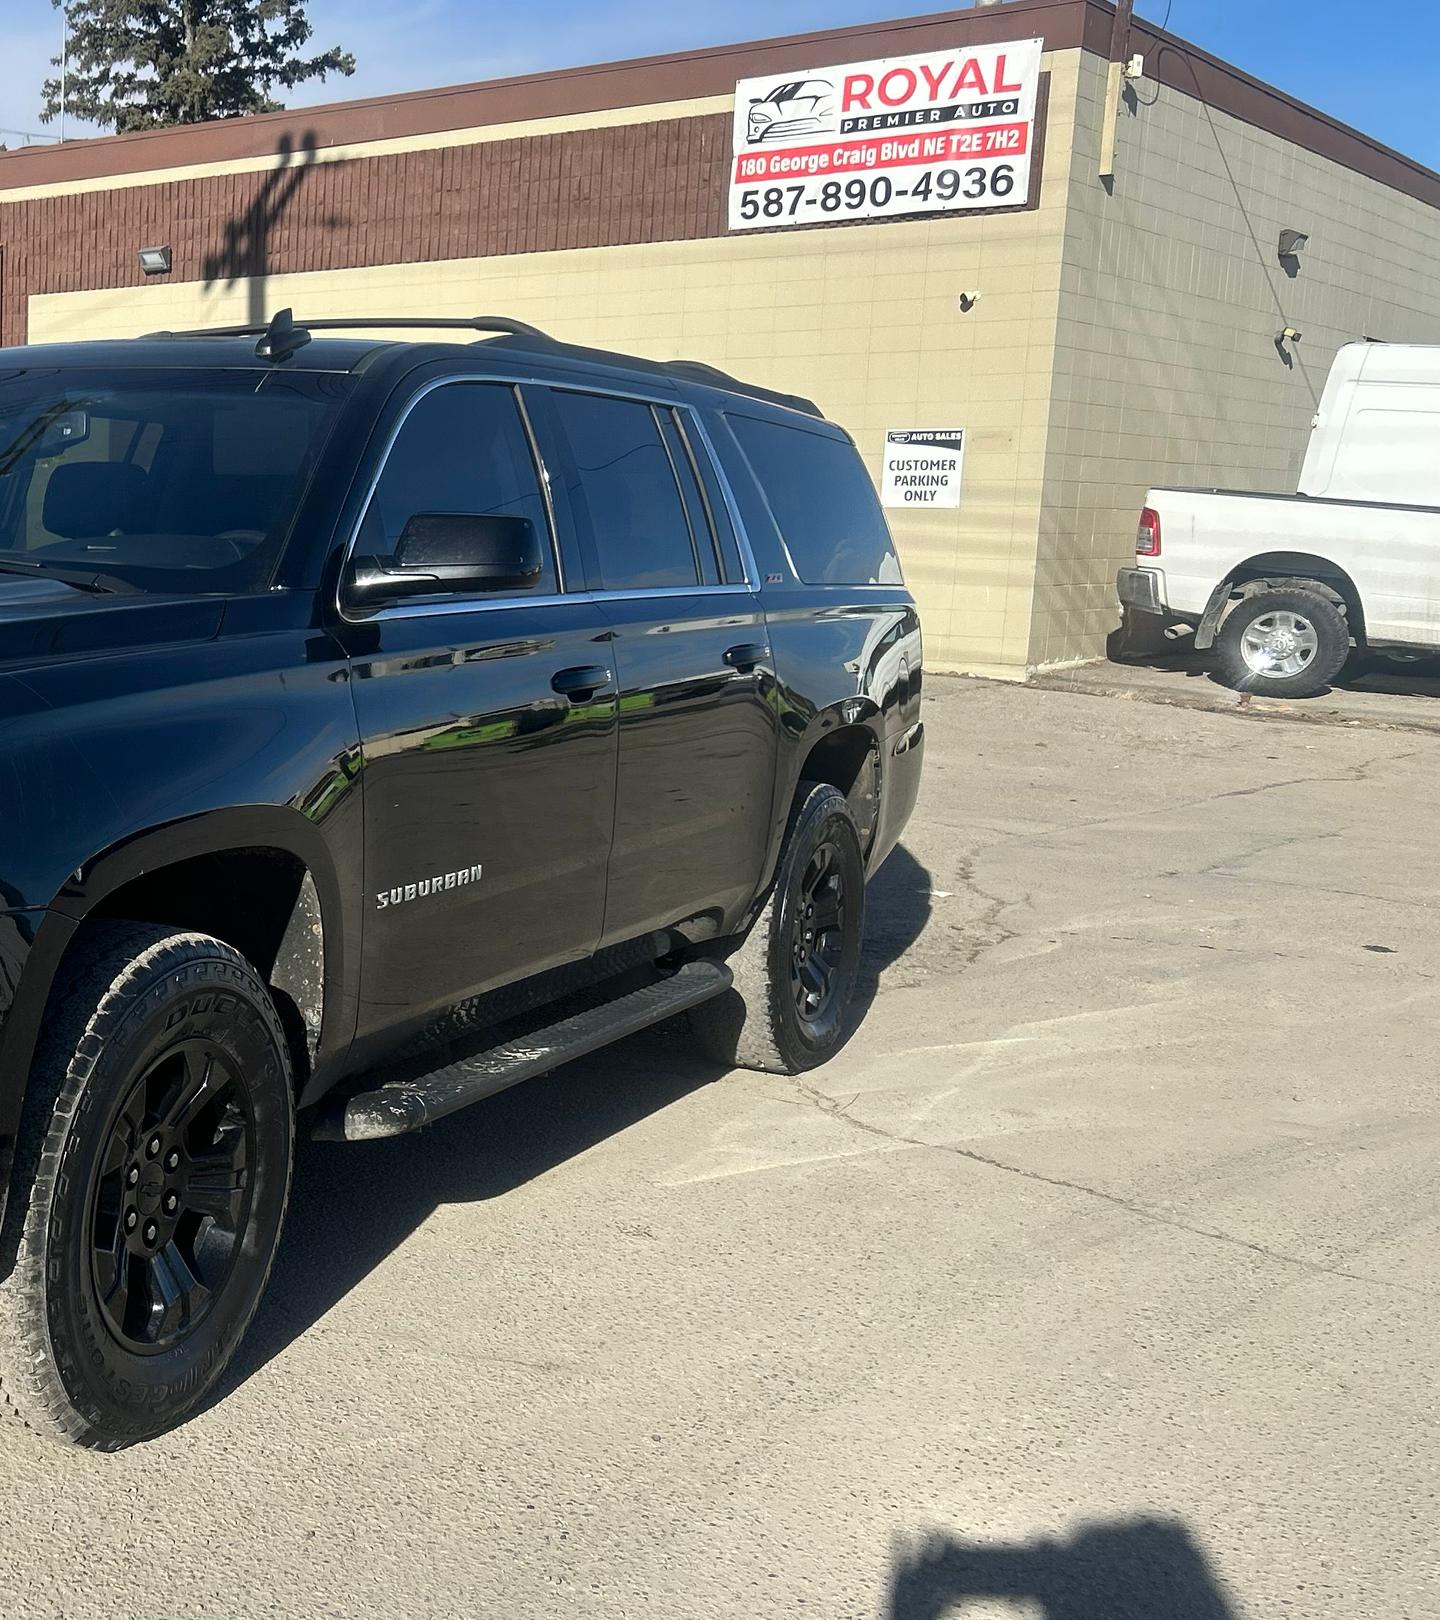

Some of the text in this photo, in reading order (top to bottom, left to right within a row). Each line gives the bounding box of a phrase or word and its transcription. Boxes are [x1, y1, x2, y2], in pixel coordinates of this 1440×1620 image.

[841, 54, 1022, 111] ROYAL
[843, 101, 1015, 132] PREMIER AUTO
[740, 129, 1020, 176] 180 George Craig Blvd NE T2E 7H2
[740, 164, 1015, 221] 587-890-4936
[911, 433, 934, 441] AUTO
[935, 432, 962, 441] SALES
[888, 459, 957, 471] CUSTOMER
[894, 475, 949, 487] PARKING
[904, 490, 937, 502] ONLY
[376, 864, 483, 910] SUBURBAN
